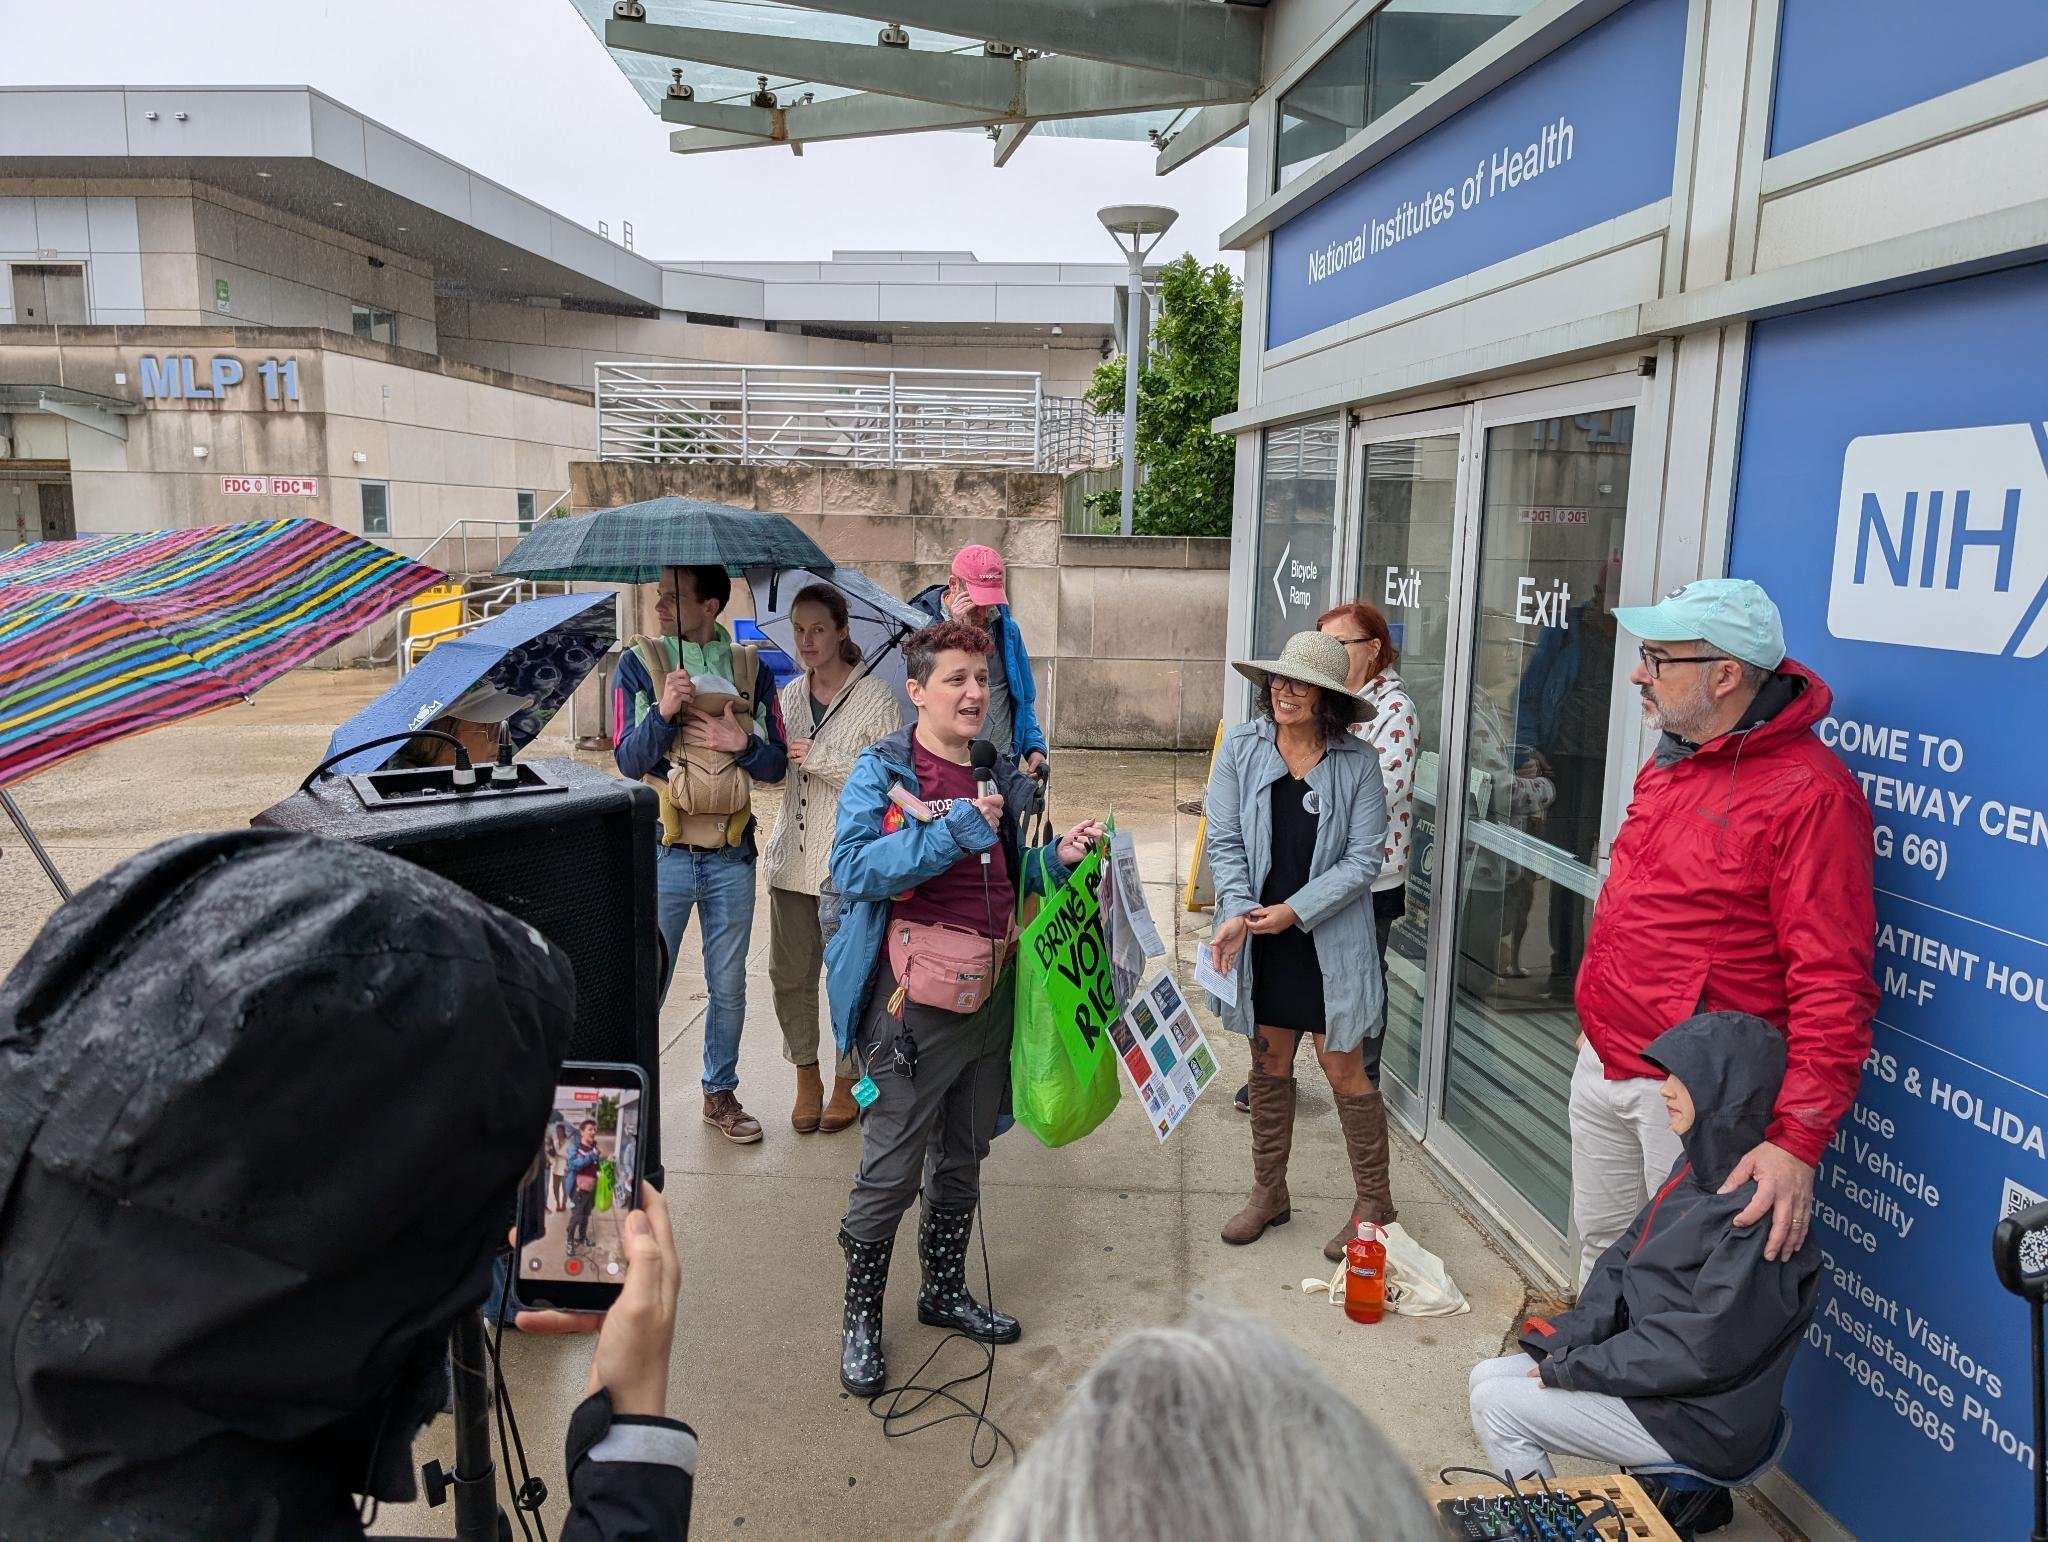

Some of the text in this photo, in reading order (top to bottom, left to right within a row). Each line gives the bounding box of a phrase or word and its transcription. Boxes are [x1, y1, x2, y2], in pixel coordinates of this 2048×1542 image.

[1308, 116, 1574, 286] National Institutes of Health
[139, 357, 299, 401] MLP 11
[224, 479, 251, 492] FDC
[273, 480, 300, 494] FDC
[1853, 488, 2021, 593] NIH
[1289, 585, 1312, 610] Ramp
[1291, 559, 1318, 583] Bicycle
[1384, 566, 1422, 609] Exit
[1515, 576, 1571, 630] Exit
[1919, 733, 1963, 773] TO
[1849, 769, 1972, 827] TEWAY
[1902, 833, 1948, 881] 66)
[1034, 897, 1087, 971] BRING
[1875, 921, 1980, 982] ATIENT
[1075, 968, 1116, 1054] RIG
[1884, 966, 1936, 1007] M-F
[1853, 1102, 1895, 1140] use
[1904, 1066, 1922, 1098] &
[1930, 1077, 2045, 1160] HOLIDA
[1853, 1135, 1940, 1207] Vehicle
[1831, 1164, 1914, 1238] Facility
[1821, 1249, 2002, 1399] Patient Visitors
[1824, 1296, 2035, 1471] Assistance Phon
